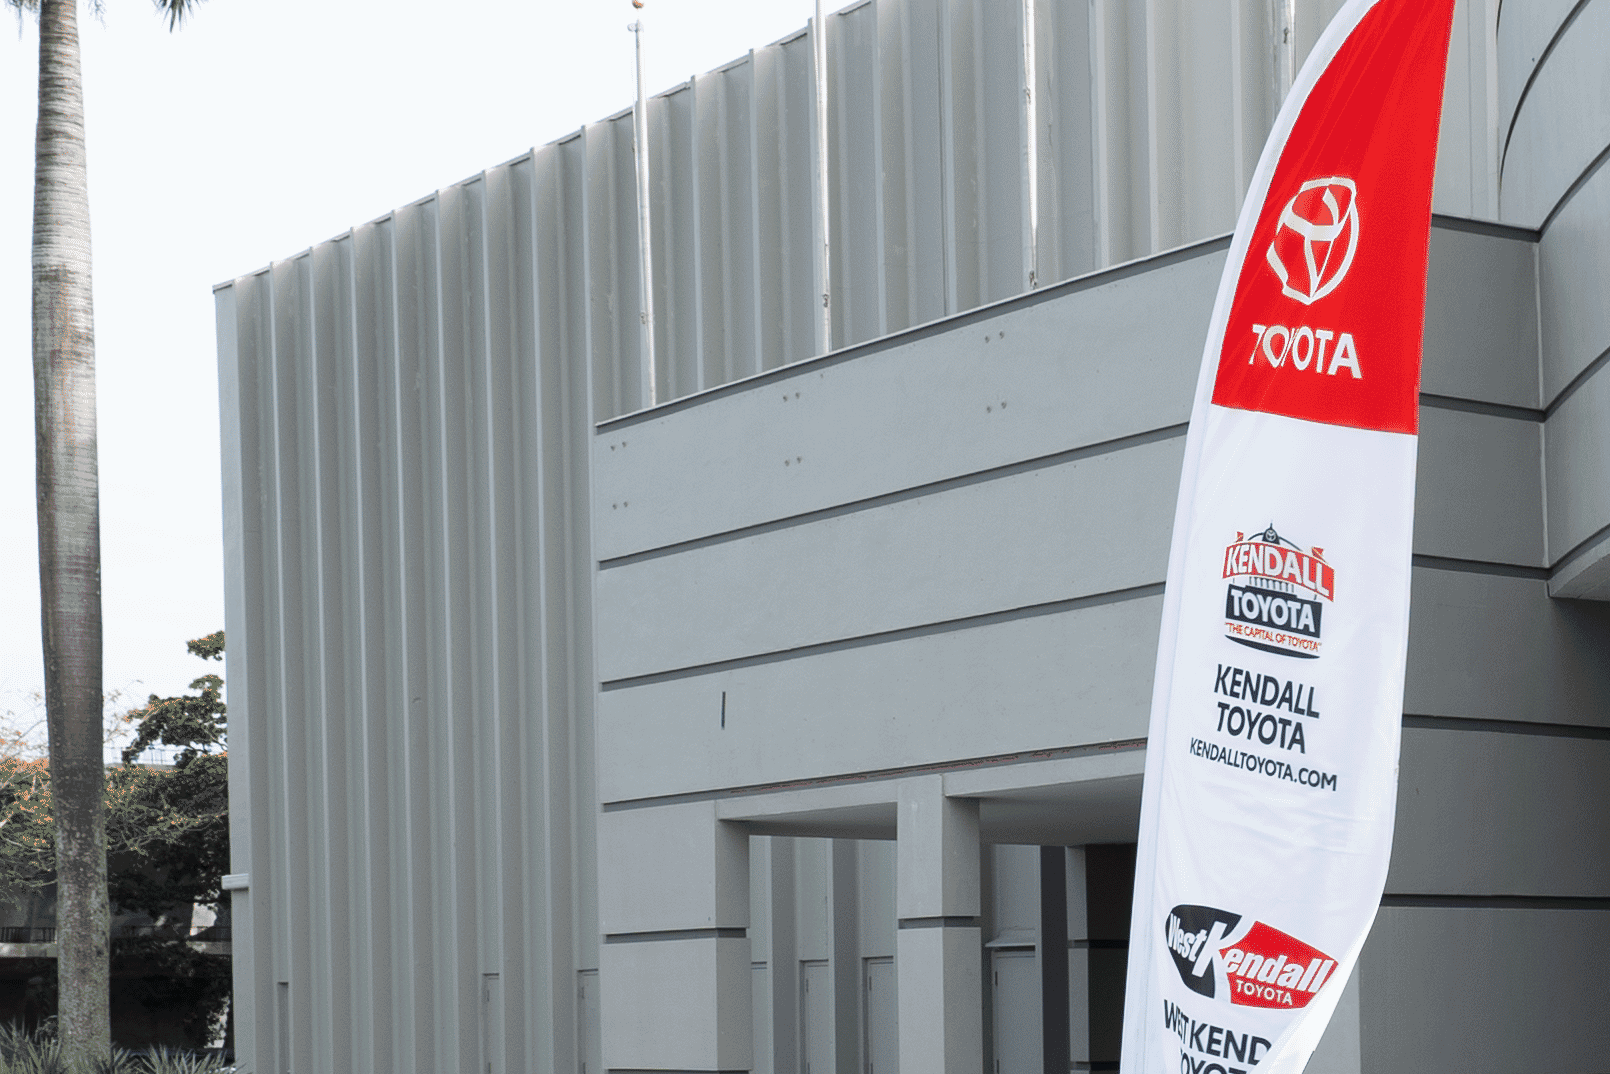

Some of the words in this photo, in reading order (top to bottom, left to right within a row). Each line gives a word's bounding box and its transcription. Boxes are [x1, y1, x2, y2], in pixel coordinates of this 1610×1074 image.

[1226, 543, 1331, 598] KENDALL
[1230, 587, 1316, 633] TOYOTA
[1243, 626, 1274, 642] CAPITAL
[1275, 632, 1289, 644] OF
[1213, 663, 1320, 719] KENDALL
[1216, 701, 1306, 755] TOYOTA
[1189, 737, 1338, 792] KENDALLTOYOTA.COM
[1168, 912, 1208, 962] West
[1191, 920, 1335, 994] Kendall
[1236, 979, 1293, 1006] TOYOTA
